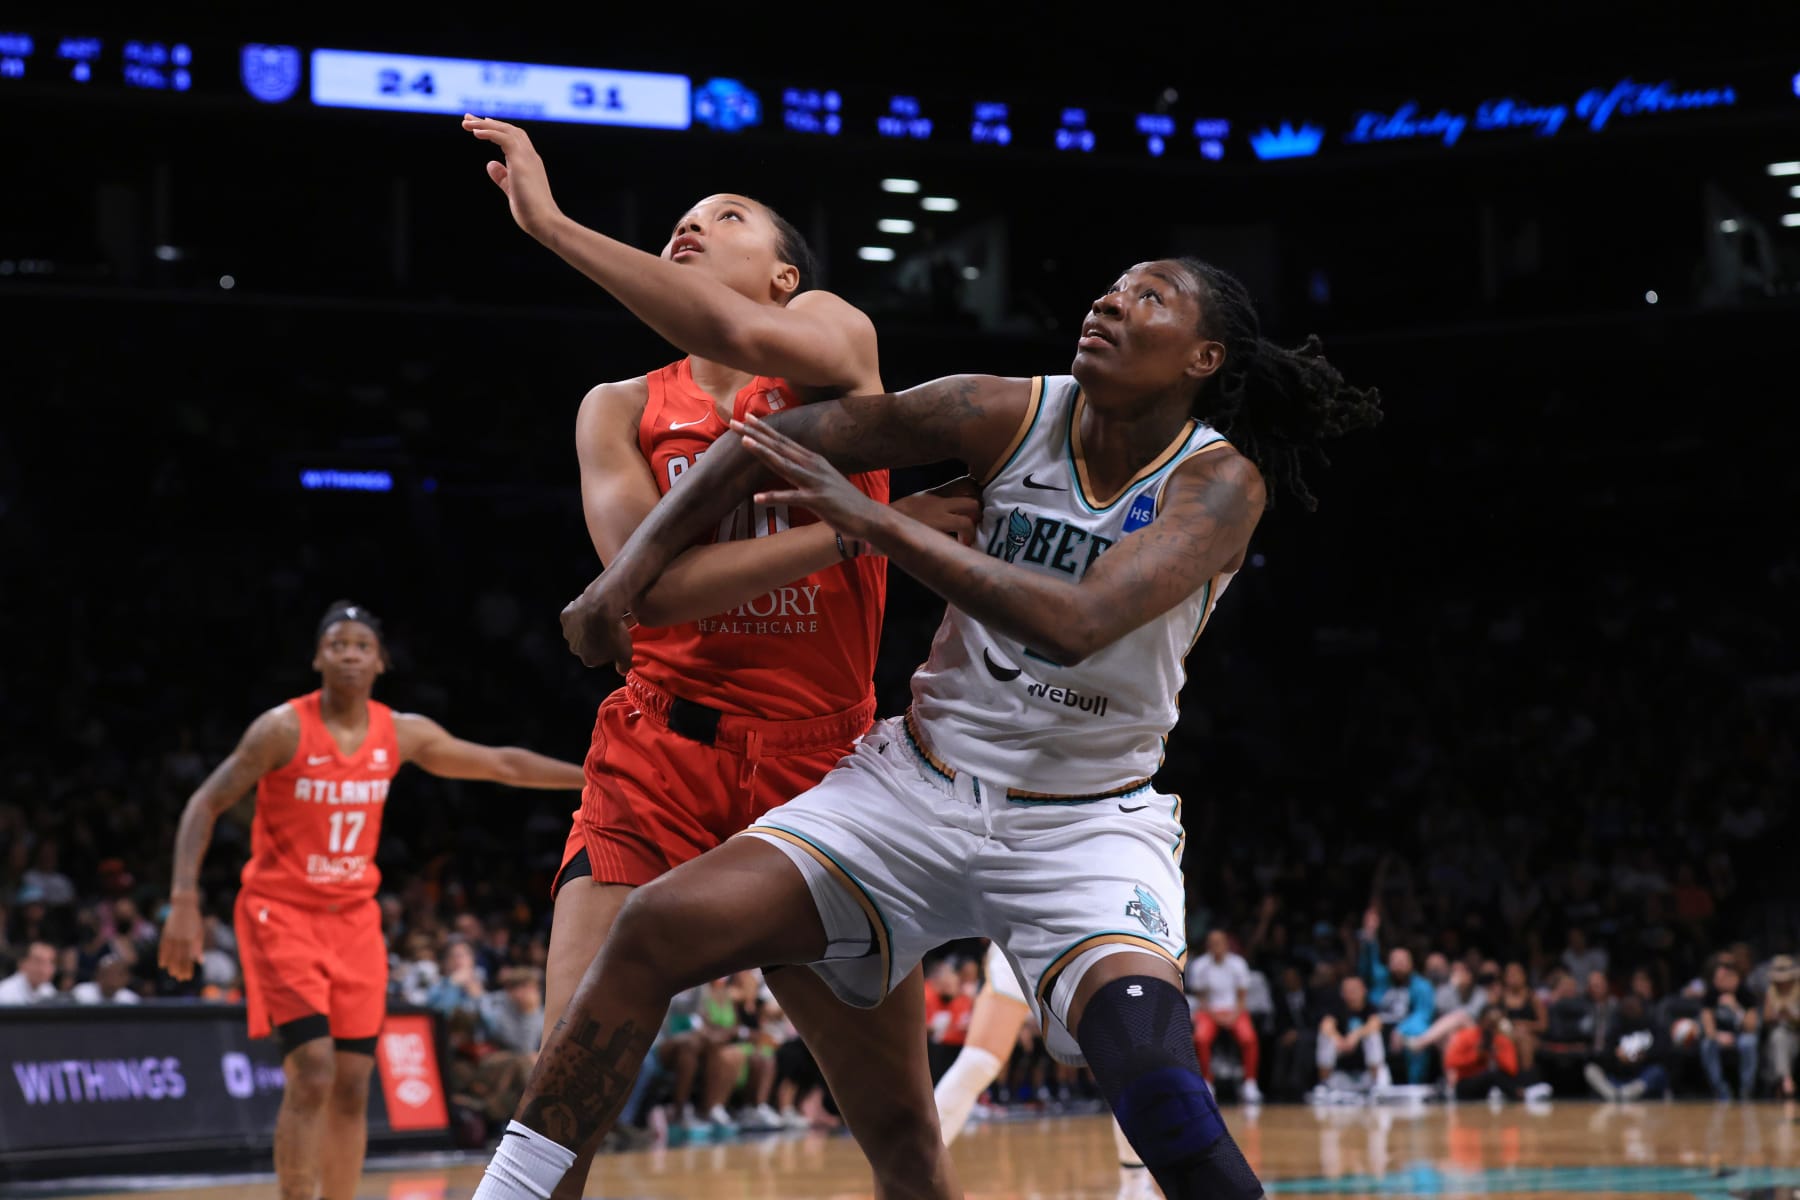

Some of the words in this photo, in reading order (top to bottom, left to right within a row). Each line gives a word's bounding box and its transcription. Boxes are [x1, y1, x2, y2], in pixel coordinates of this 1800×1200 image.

[377, 69, 435, 96] 24
[1130, 506, 1154, 523] HS
[698, 619, 818, 634] HEALTHCARE
[328, 811, 366, 853] 17
[12, 1056, 187, 1104] WITHINGS
